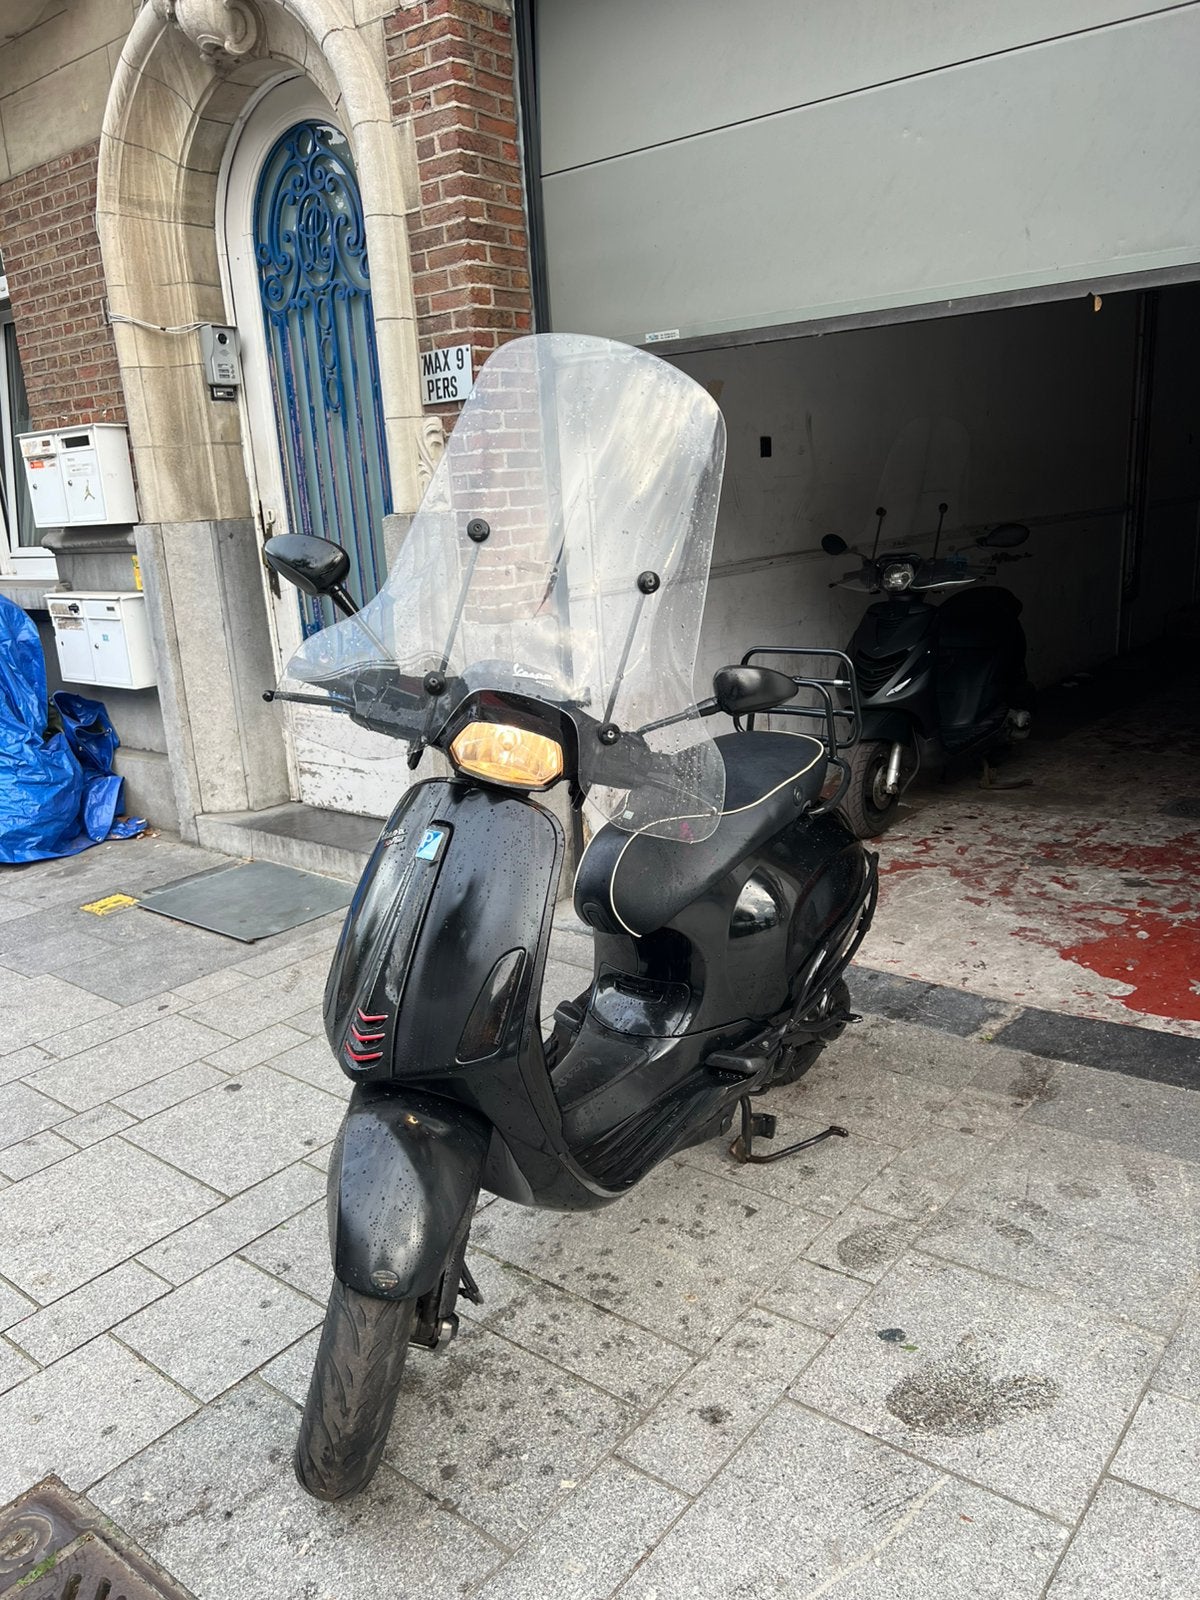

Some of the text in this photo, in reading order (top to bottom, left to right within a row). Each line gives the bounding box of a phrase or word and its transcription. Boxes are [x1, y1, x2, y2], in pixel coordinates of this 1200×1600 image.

[423, 348, 464, 376] MAX 9
[427, 375, 458, 401] PERS
